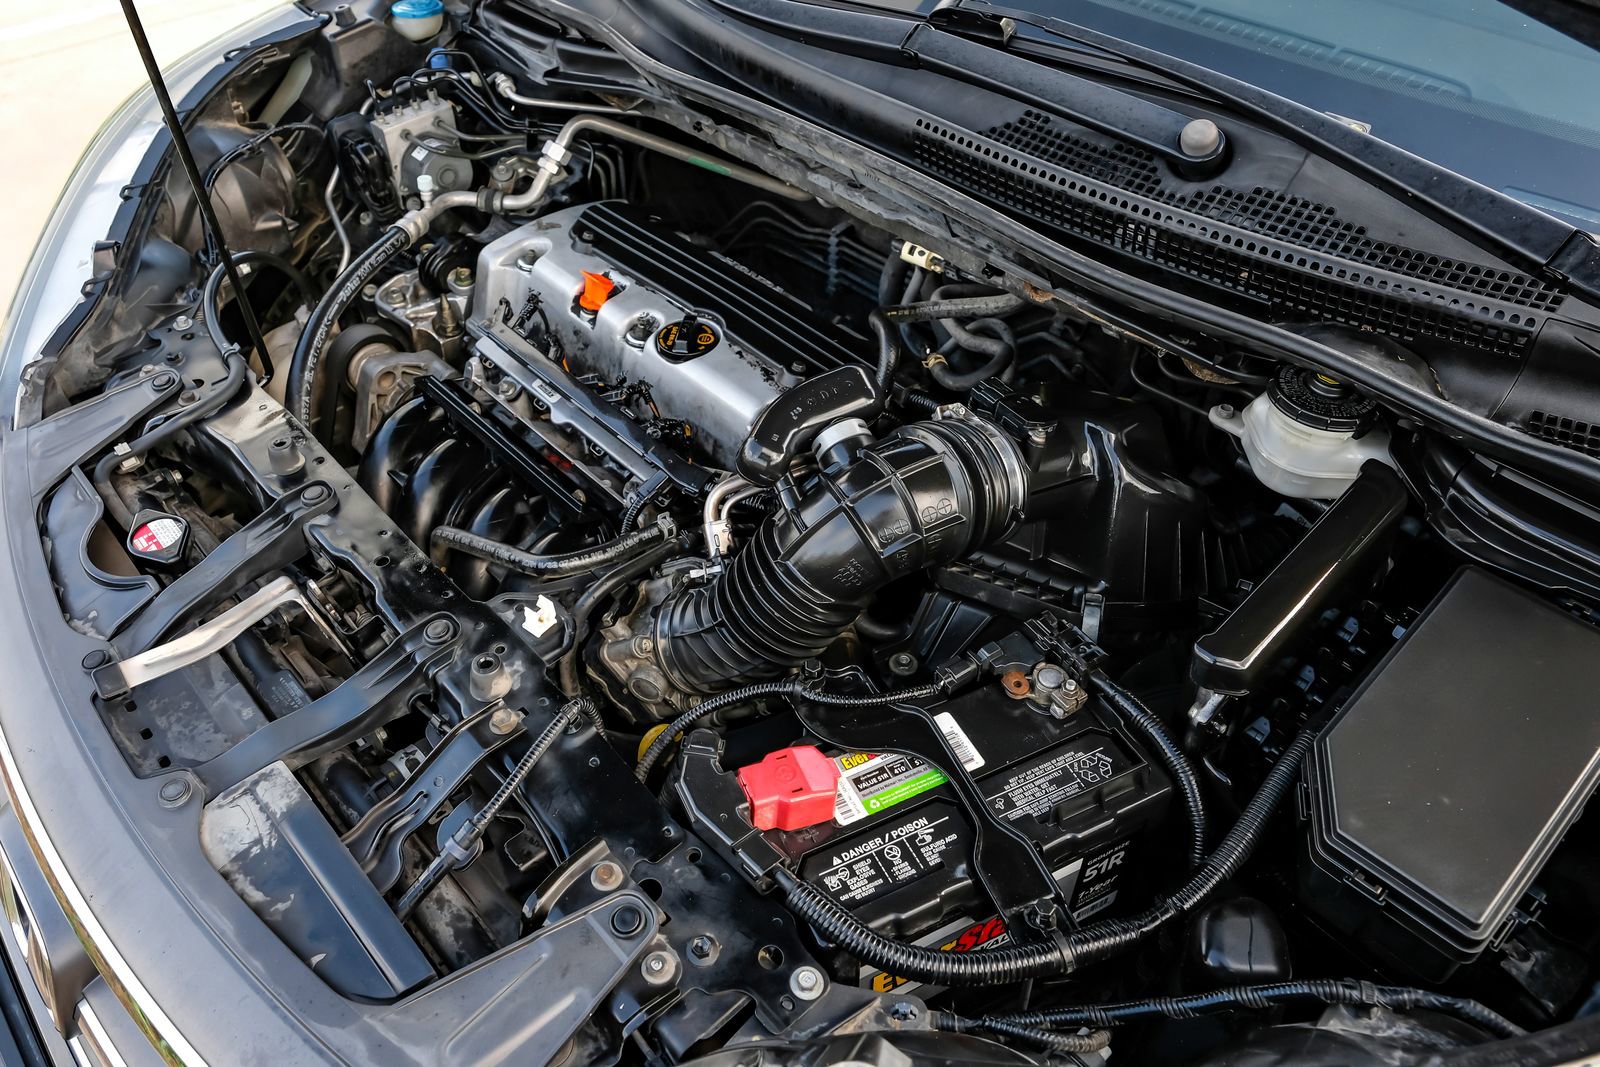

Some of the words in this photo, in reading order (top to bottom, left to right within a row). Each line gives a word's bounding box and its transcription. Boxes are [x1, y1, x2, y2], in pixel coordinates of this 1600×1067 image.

[893, 765, 906, 774] 410
[857, 776, 878, 790] VALUE
[876, 771, 889, 781] 51R
[841, 836, 883, 861] DANGER
[890, 816, 928, 839] POISON
[920, 838, 945, 853] SULFURIC
[855, 865, 870, 875] EYES
[1083, 851, 1125, 883] 51R
[846, 868, 876, 886] EXPLOSIVE
